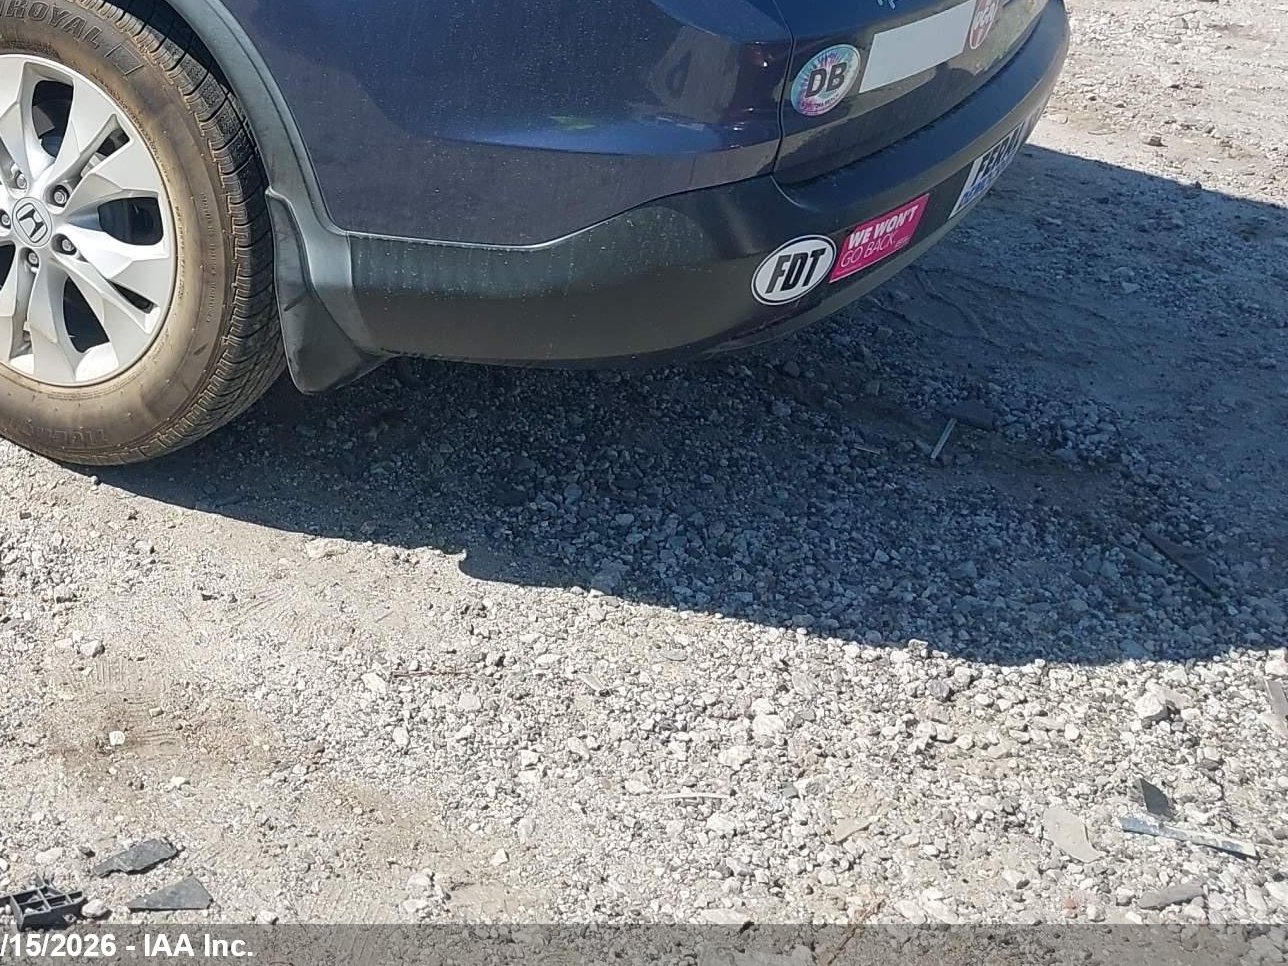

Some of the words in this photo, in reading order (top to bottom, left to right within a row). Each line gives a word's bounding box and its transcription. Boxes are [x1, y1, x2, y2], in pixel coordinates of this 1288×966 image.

[805, 62, 848, 99] DB
[848, 226, 874, 251] WE
[873, 204, 919, 240] WON'T
[765, 247, 828, 294] FDT
[840, 246, 864, 268] GO
